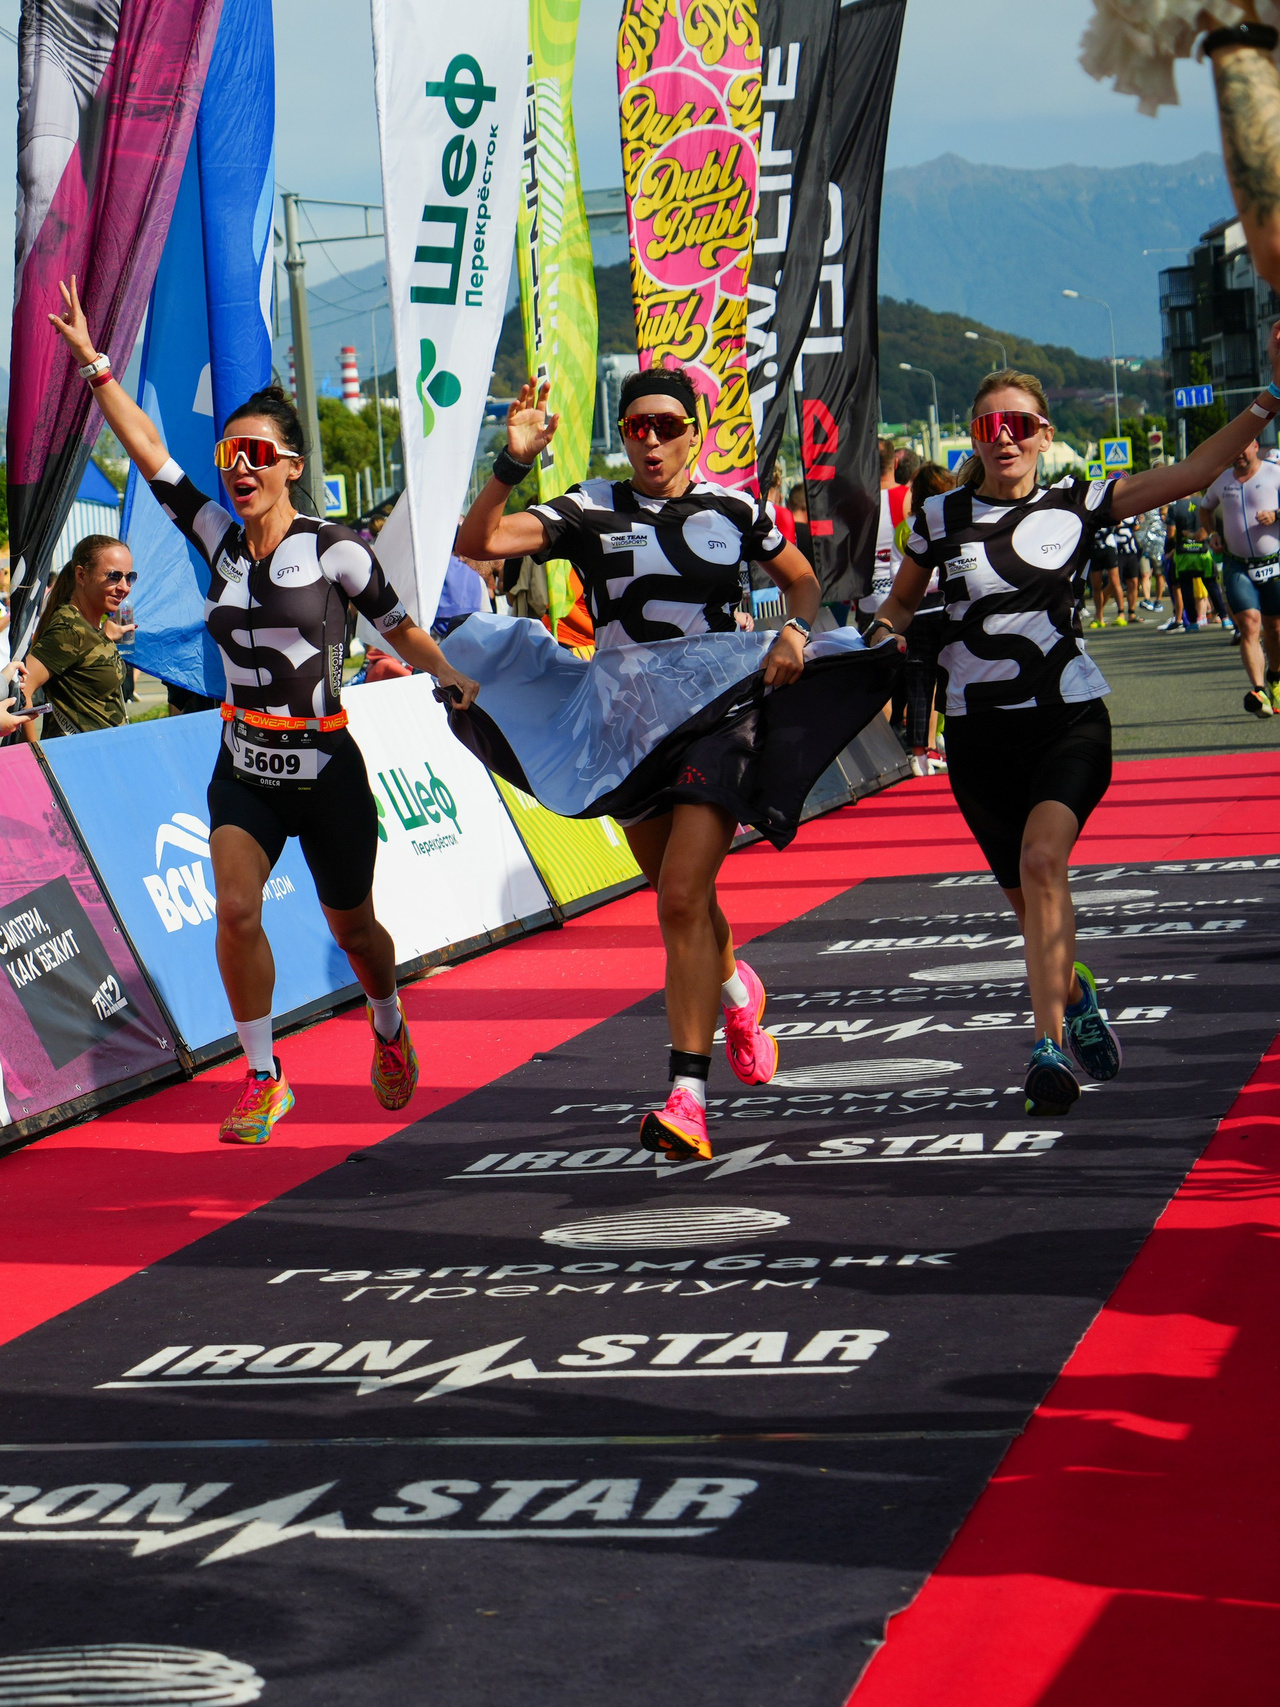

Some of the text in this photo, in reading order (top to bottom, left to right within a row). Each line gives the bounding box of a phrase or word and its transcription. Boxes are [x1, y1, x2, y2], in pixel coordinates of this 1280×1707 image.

[410, 53, 497, 306] Шеф
[633, 142, 743, 221] Dubl
[465, 123, 499, 307] Перекрёсток
[645, 175, 754, 269] Bubl
[230, 564, 243, 577] TEAM
[958, 556, 977, 565] TEAM
[1255, 567, 1274, 578] 4179
[243, 712, 306, 730] POWERUP
[244, 746, 300, 775] 5609
[260, 777, 281, 787] ОЛЕСЯ
[378, 762, 463, 835] Шеф
[411, 833, 460, 857] Перекрёсток
[142, 860, 217, 934] ВСК
[272, 874, 296, 901] ДОМ
[827, 919, 1247, 951] IRON STAR
[6, 928, 81, 989] КАК БЕЖИТ
[91, 974, 129, 1021] TELE2
[808, 1130, 1064, 1158] STAR
[121, 1329, 891, 1377] IRON STAR
[372, 1477, 760, 1522] STAR
